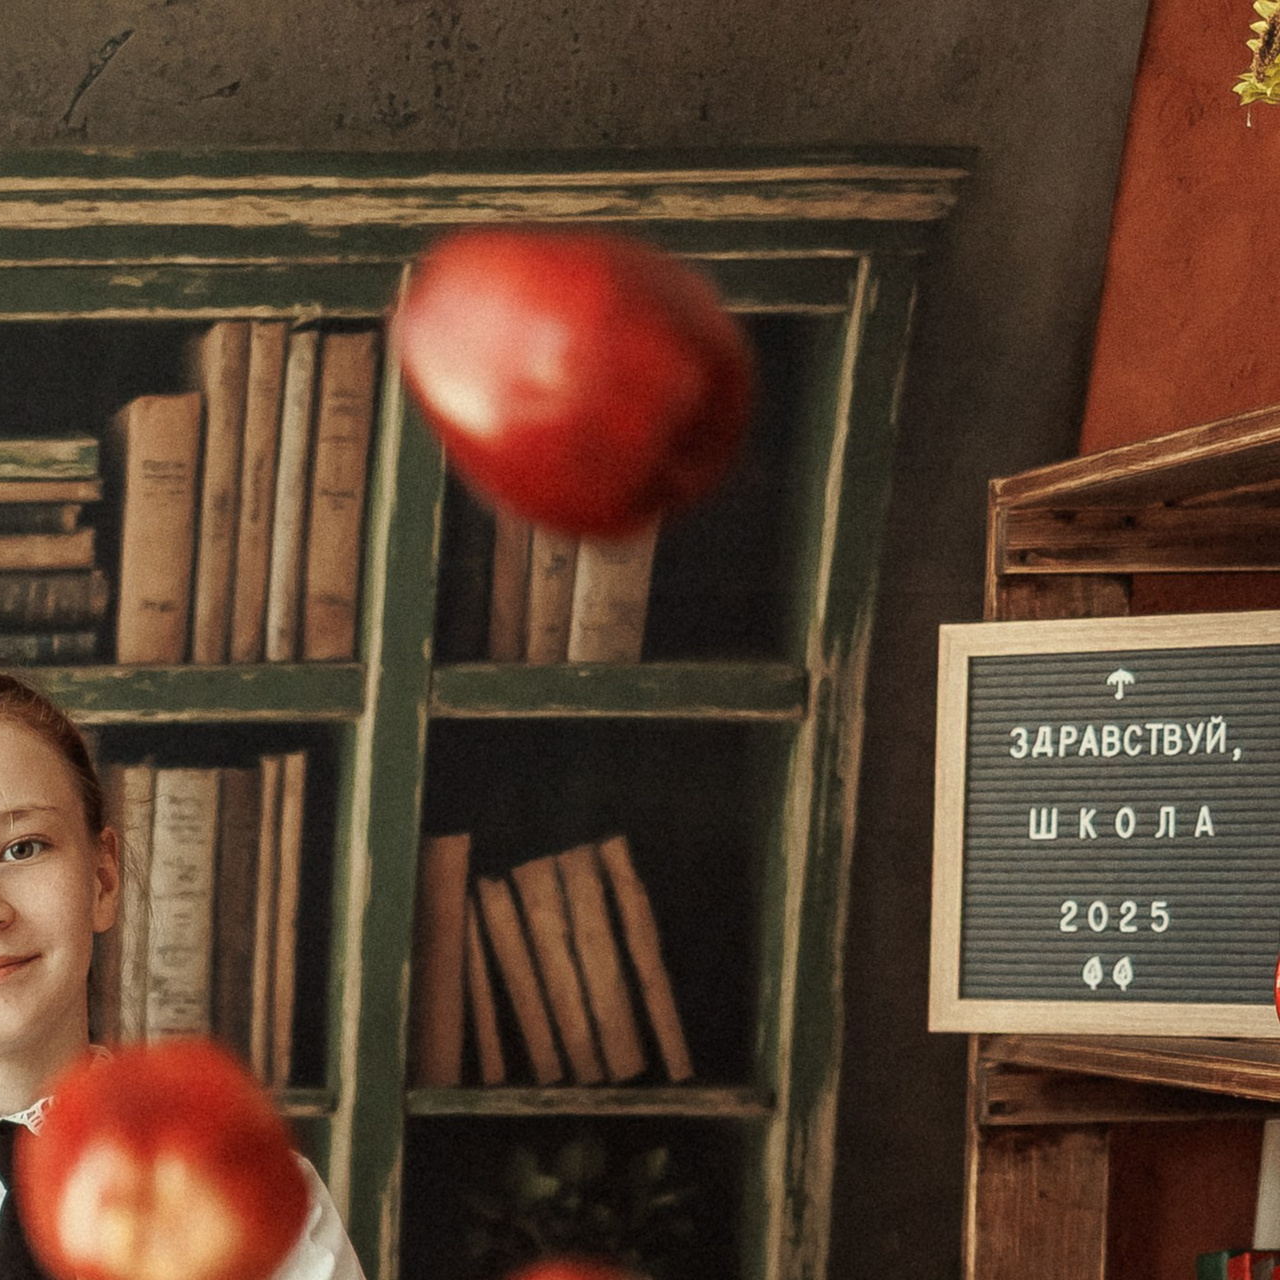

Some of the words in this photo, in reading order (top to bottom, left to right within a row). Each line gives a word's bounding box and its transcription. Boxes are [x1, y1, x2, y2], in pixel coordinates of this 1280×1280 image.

[1009, 715, 1242, 762] ЗДРАВСТВУЙ,
[1028, 804, 1216, 841] ШКОЛА
[1059, 900, 1171, 933] 2025
